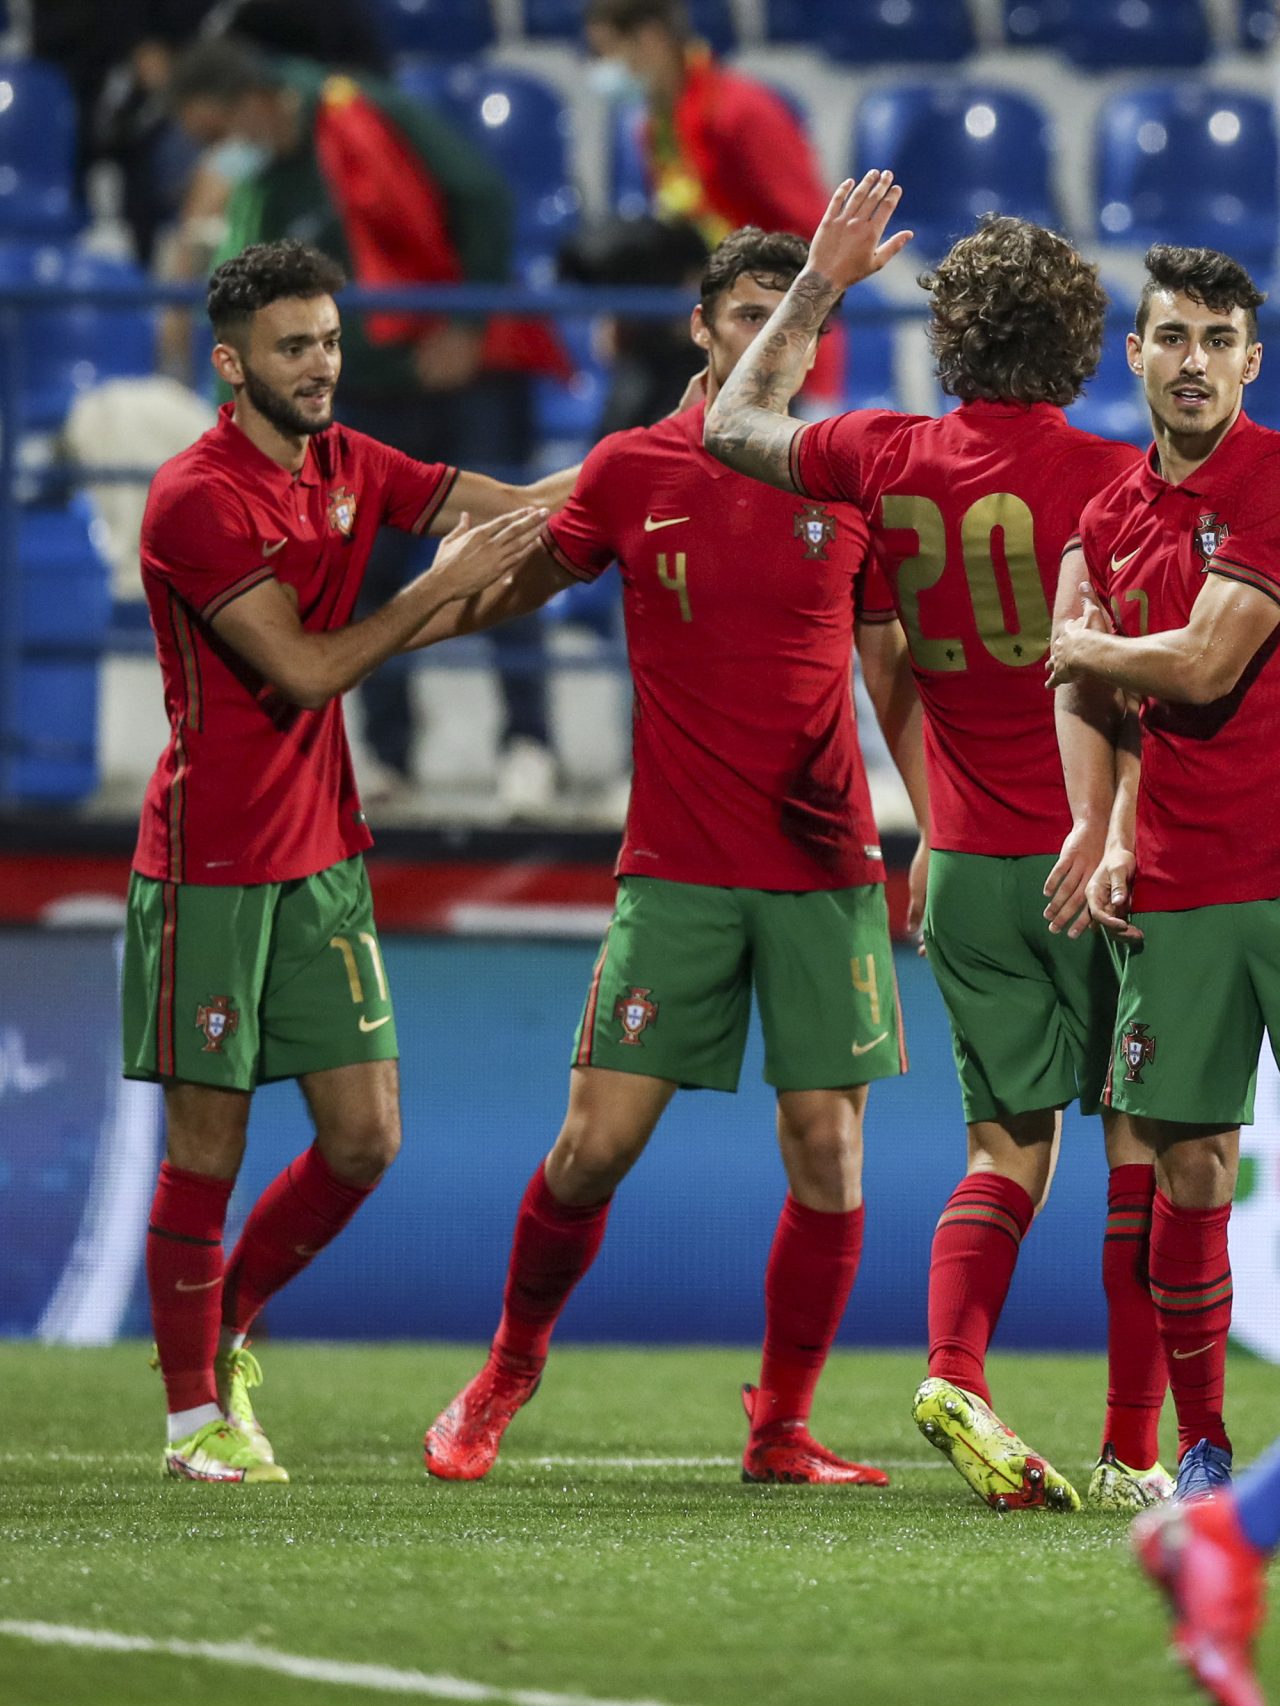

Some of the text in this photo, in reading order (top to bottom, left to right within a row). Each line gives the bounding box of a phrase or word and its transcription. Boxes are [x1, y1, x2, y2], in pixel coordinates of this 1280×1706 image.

[656, 552, 693, 623] 4
[880, 492, 1051, 671] 20
[329, 931, 387, 1003] 11
[849, 953, 881, 1025] 4
